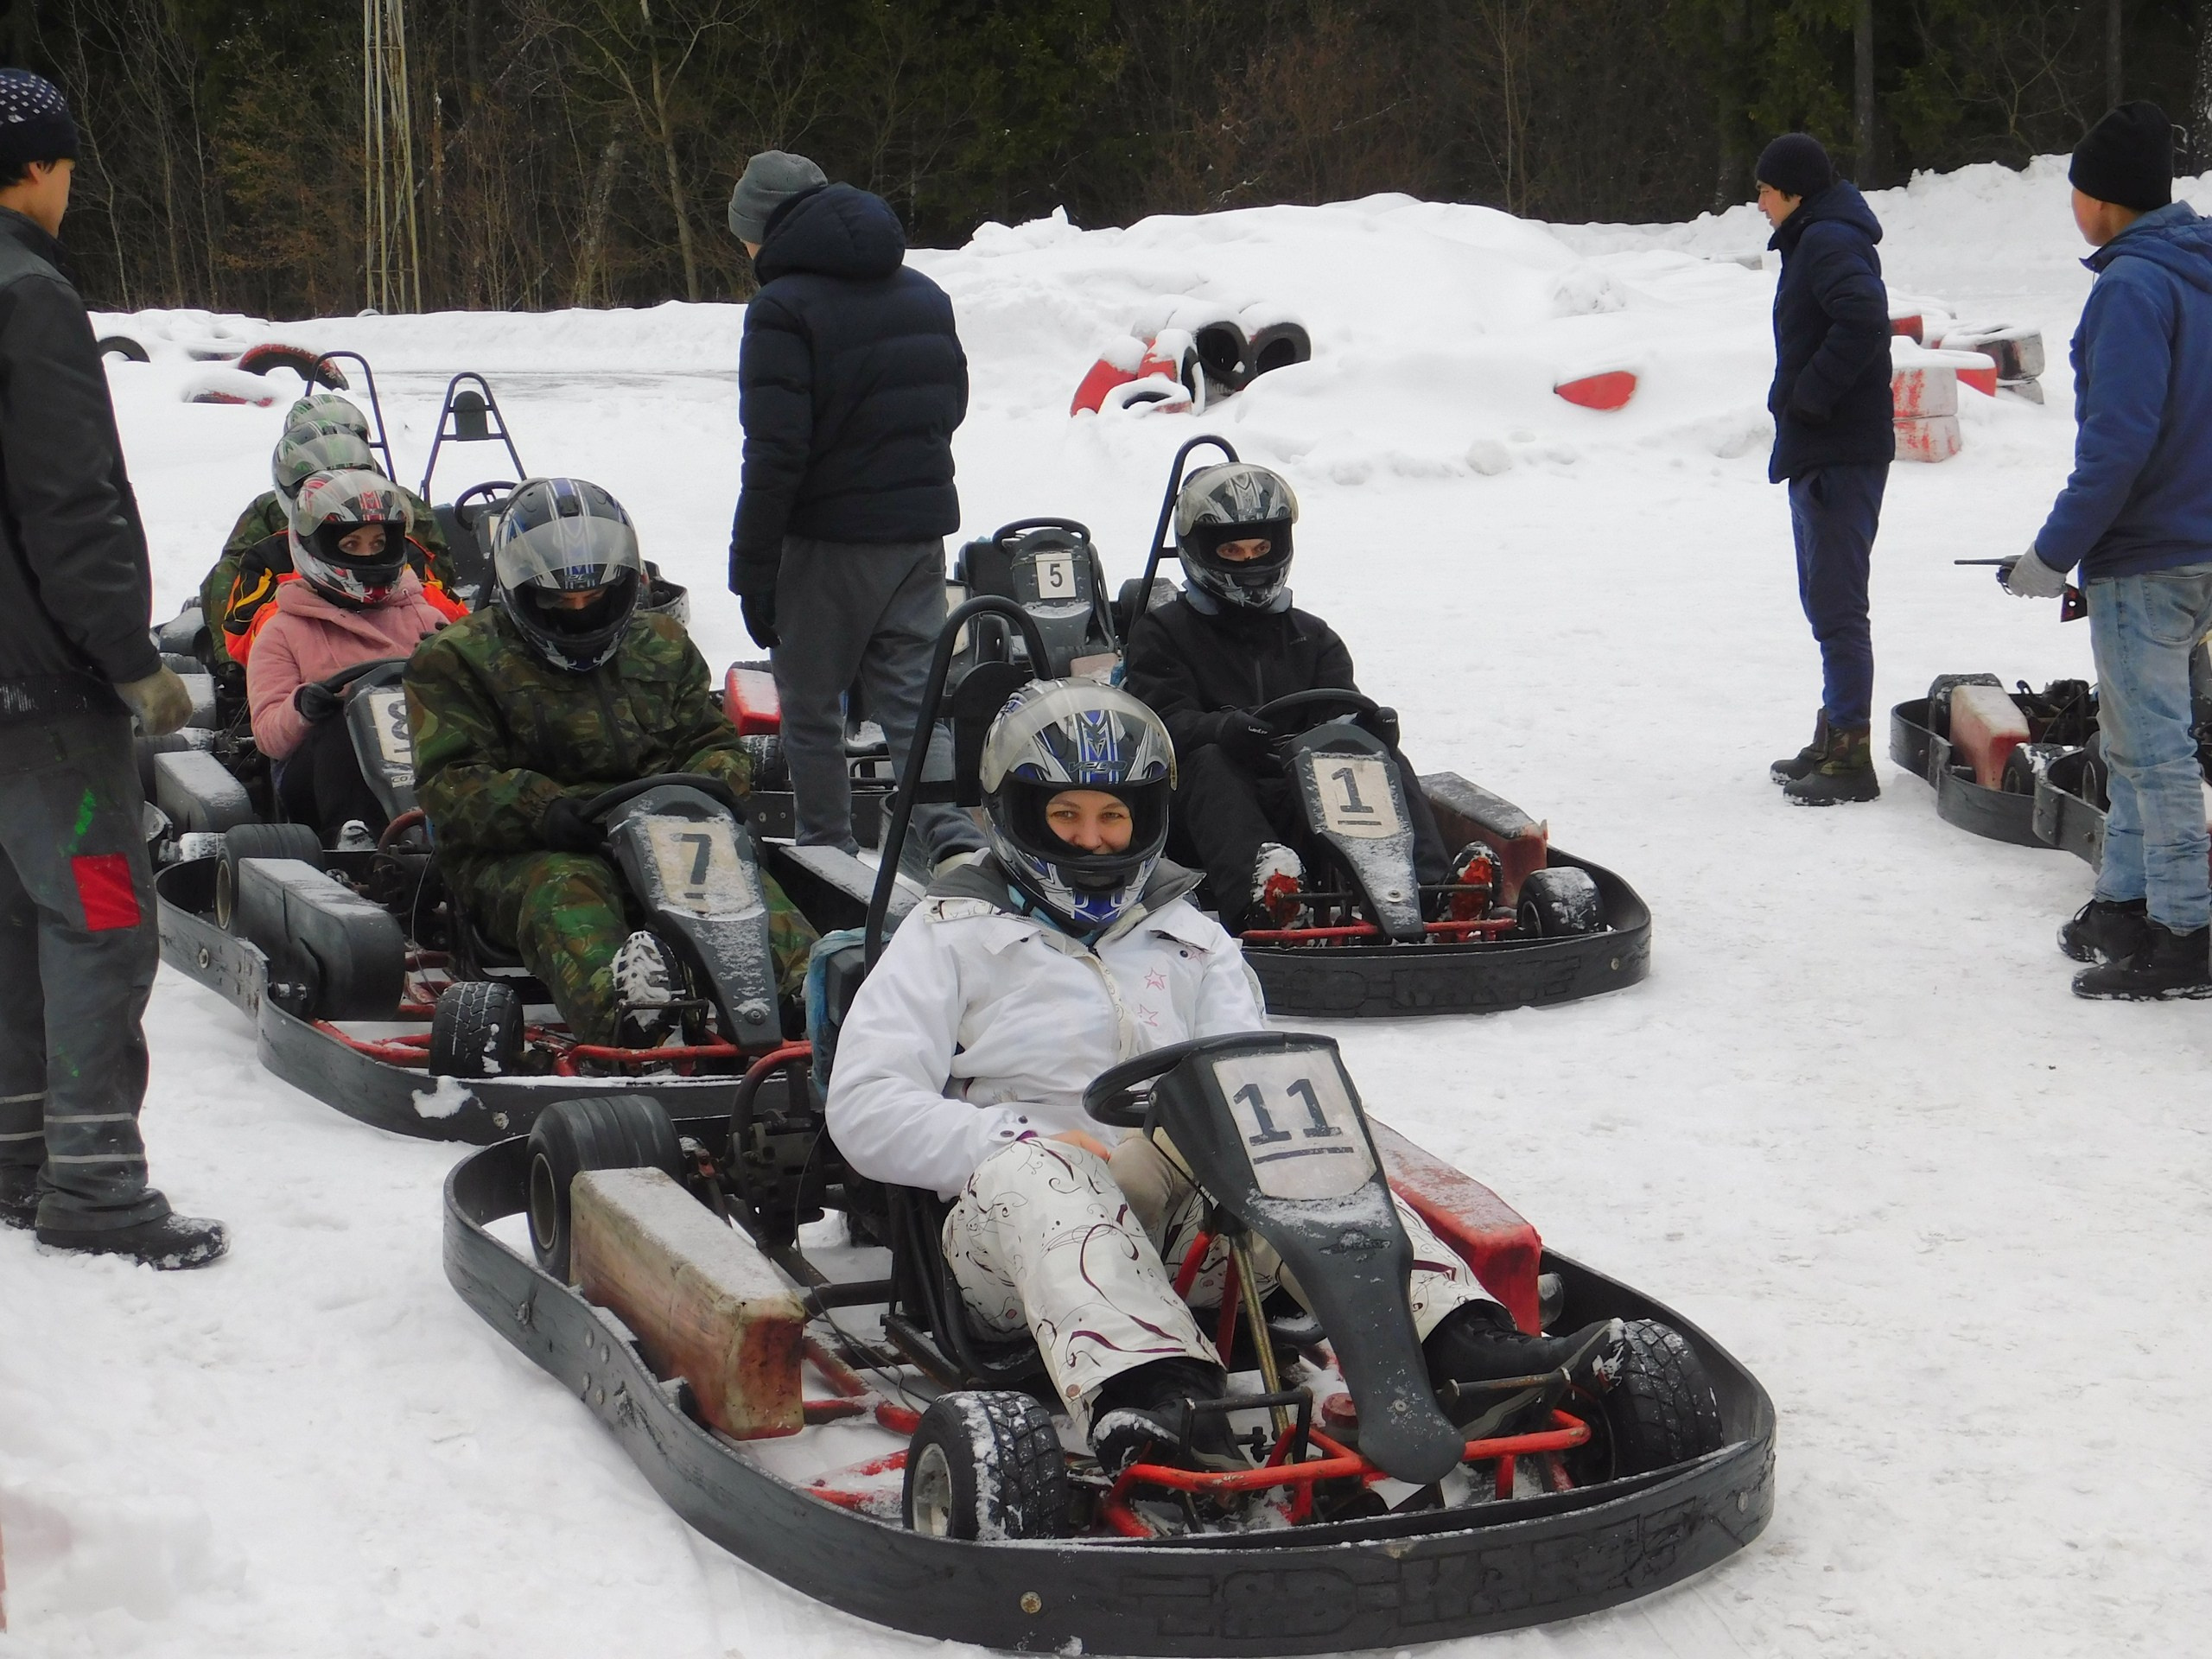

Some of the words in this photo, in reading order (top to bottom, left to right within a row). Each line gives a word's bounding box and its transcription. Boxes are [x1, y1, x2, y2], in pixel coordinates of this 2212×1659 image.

[1050, 563, 1063, 588] 5
[1331, 767, 1374, 813] 1
[670, 833, 713, 885] 7
[1233, 1078, 1343, 1147] 11
